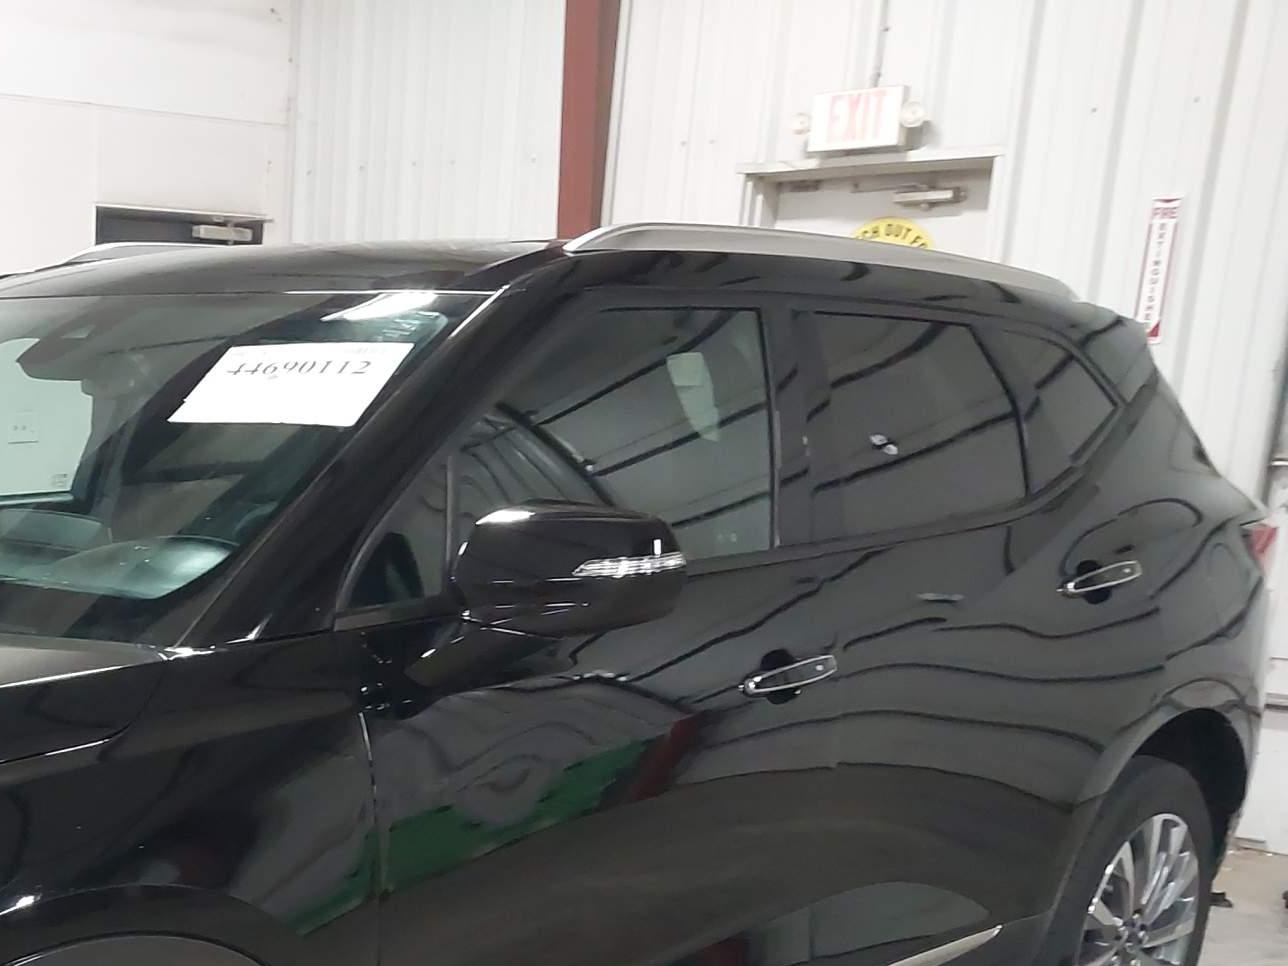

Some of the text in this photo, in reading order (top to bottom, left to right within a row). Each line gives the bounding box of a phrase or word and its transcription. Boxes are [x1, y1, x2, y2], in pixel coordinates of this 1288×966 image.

[826, 89, 888, 144] EXIT
[1151, 206, 1179, 220] FIRE
[885, 223, 913, 240] OUT
[1144, 222, 1167, 321] EXTINGUISHE
[227, 360, 372, 375] 44690112
